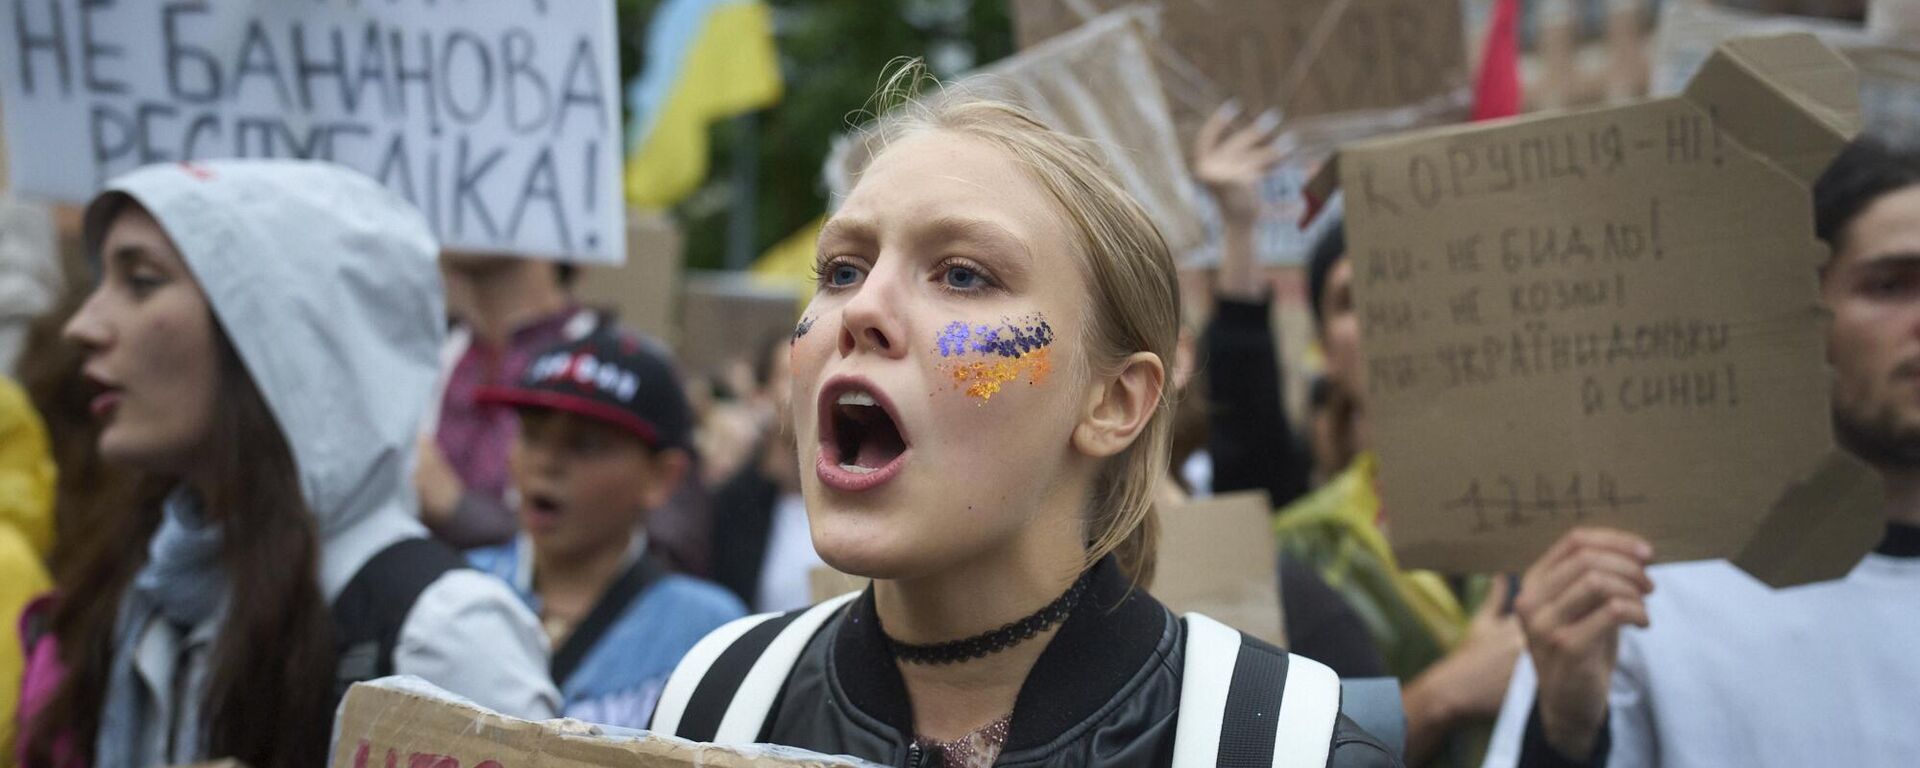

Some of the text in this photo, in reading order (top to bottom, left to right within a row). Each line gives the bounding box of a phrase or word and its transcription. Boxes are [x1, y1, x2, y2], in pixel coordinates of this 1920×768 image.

[13, 0, 609, 137] НЕ БАНАНОВА
[1446, 233, 1483, 274] НЕ
[1500, 198, 1663, 274] БИДЛО!
